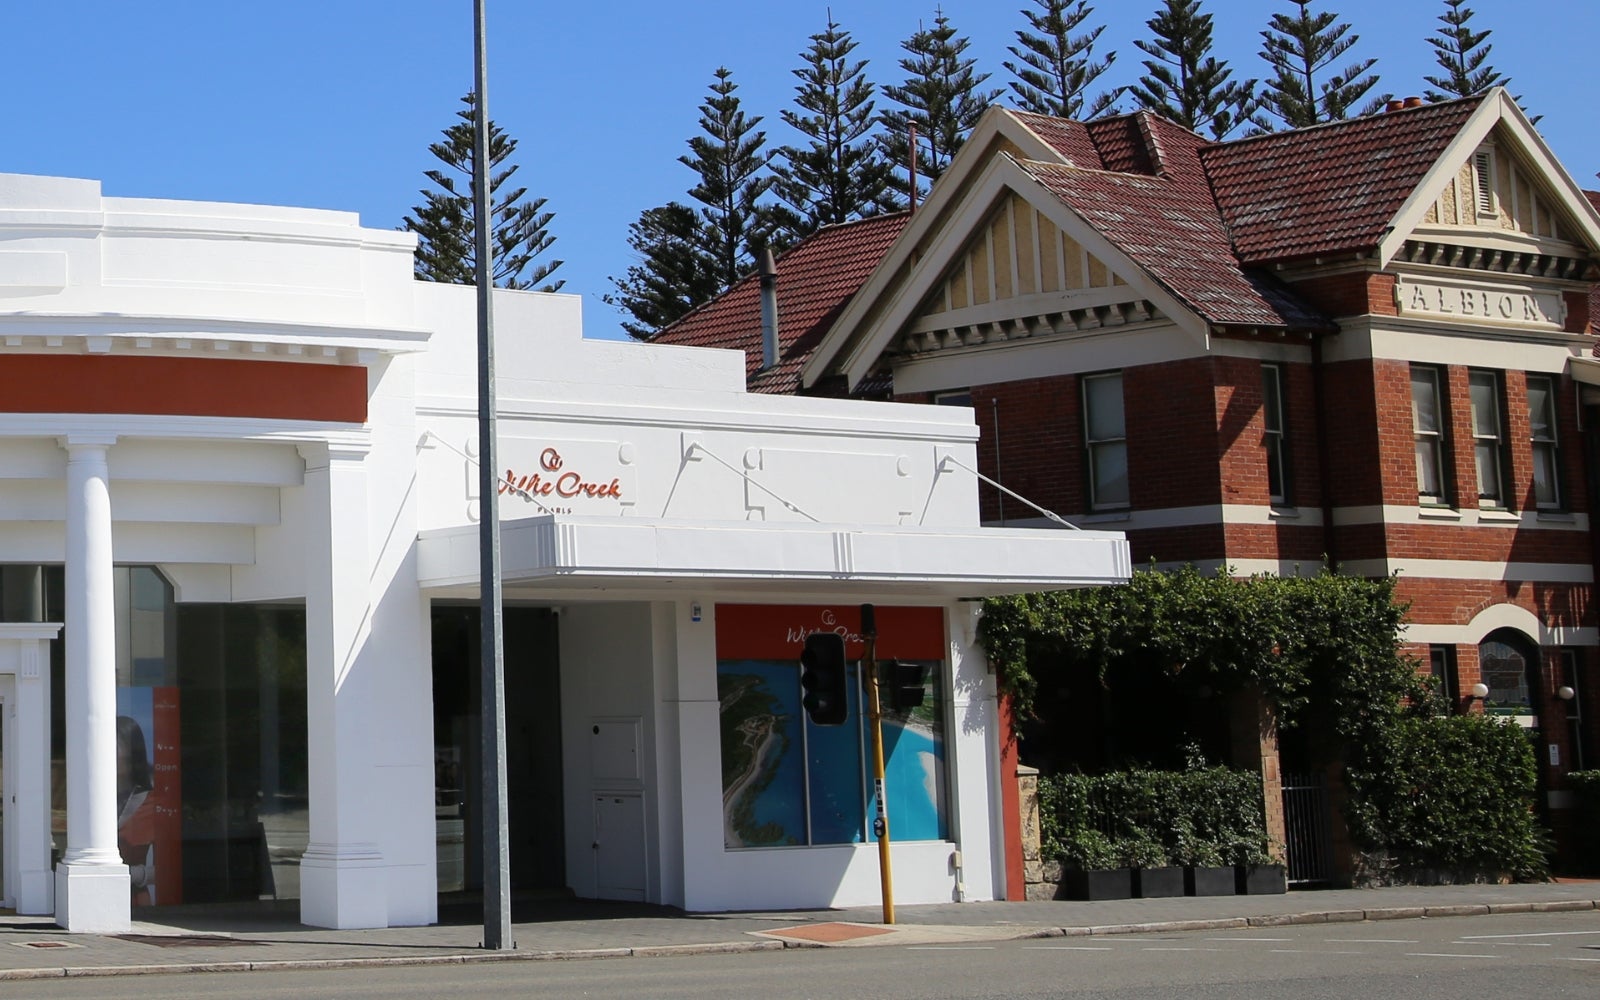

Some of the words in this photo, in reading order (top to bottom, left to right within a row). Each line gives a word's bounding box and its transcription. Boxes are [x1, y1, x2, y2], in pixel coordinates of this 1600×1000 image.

[1410, 283, 1541, 323] ALBION
[556, 472, 622, 498] Creek
[155, 763, 177, 772] Open
